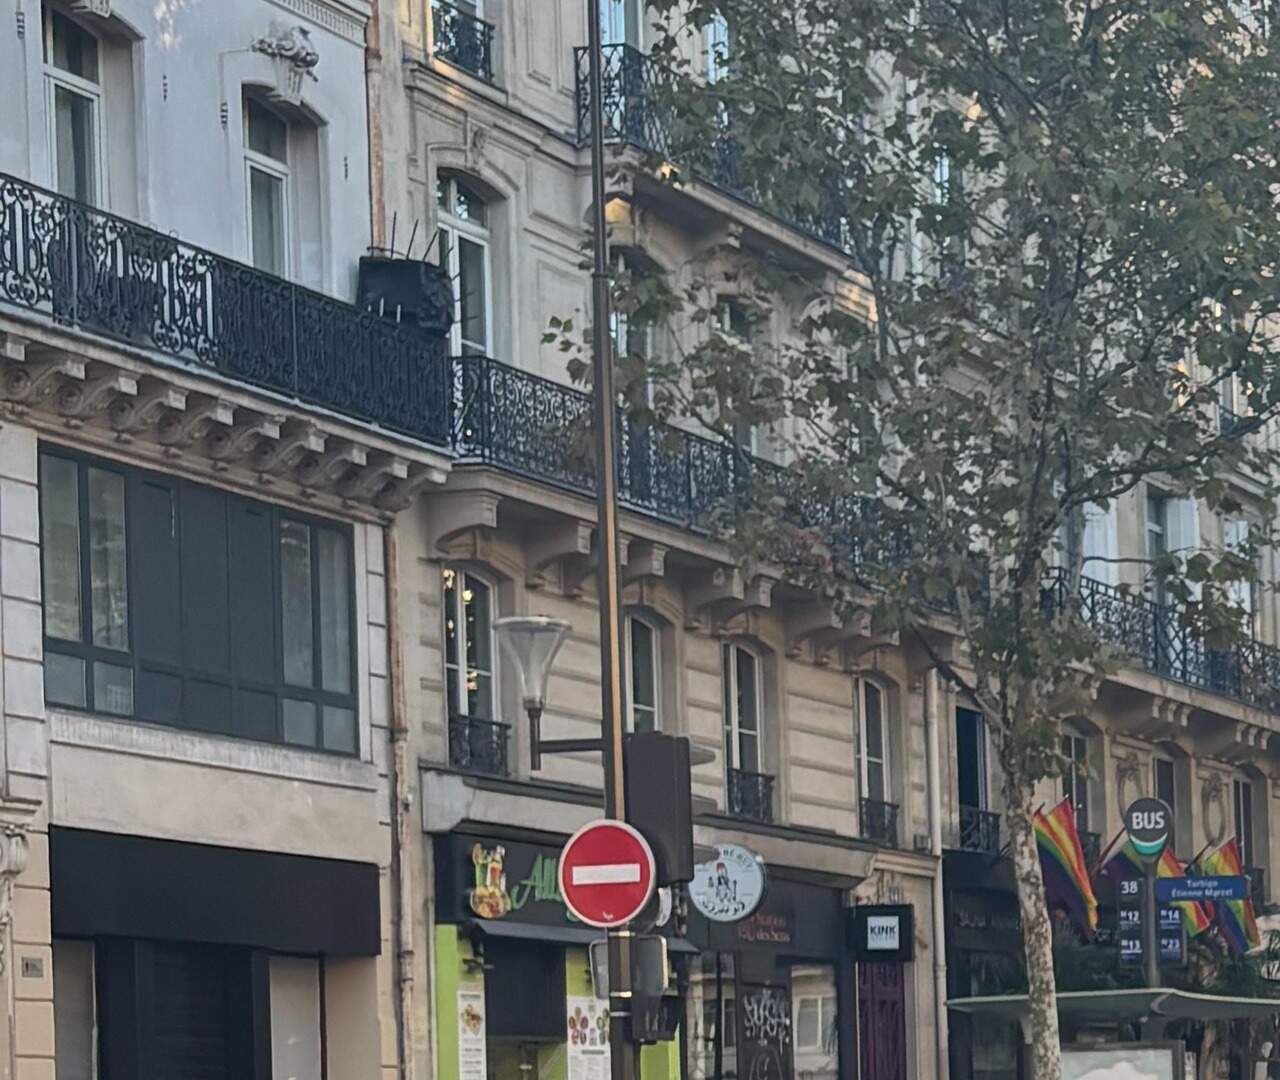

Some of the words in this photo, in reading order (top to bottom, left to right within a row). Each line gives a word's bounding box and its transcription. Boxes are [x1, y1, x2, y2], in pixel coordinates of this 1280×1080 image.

[1132, 811, 1165, 829] BUS
[1121, 881, 1138, 894] 38
[869, 924, 897, 936] KINK
